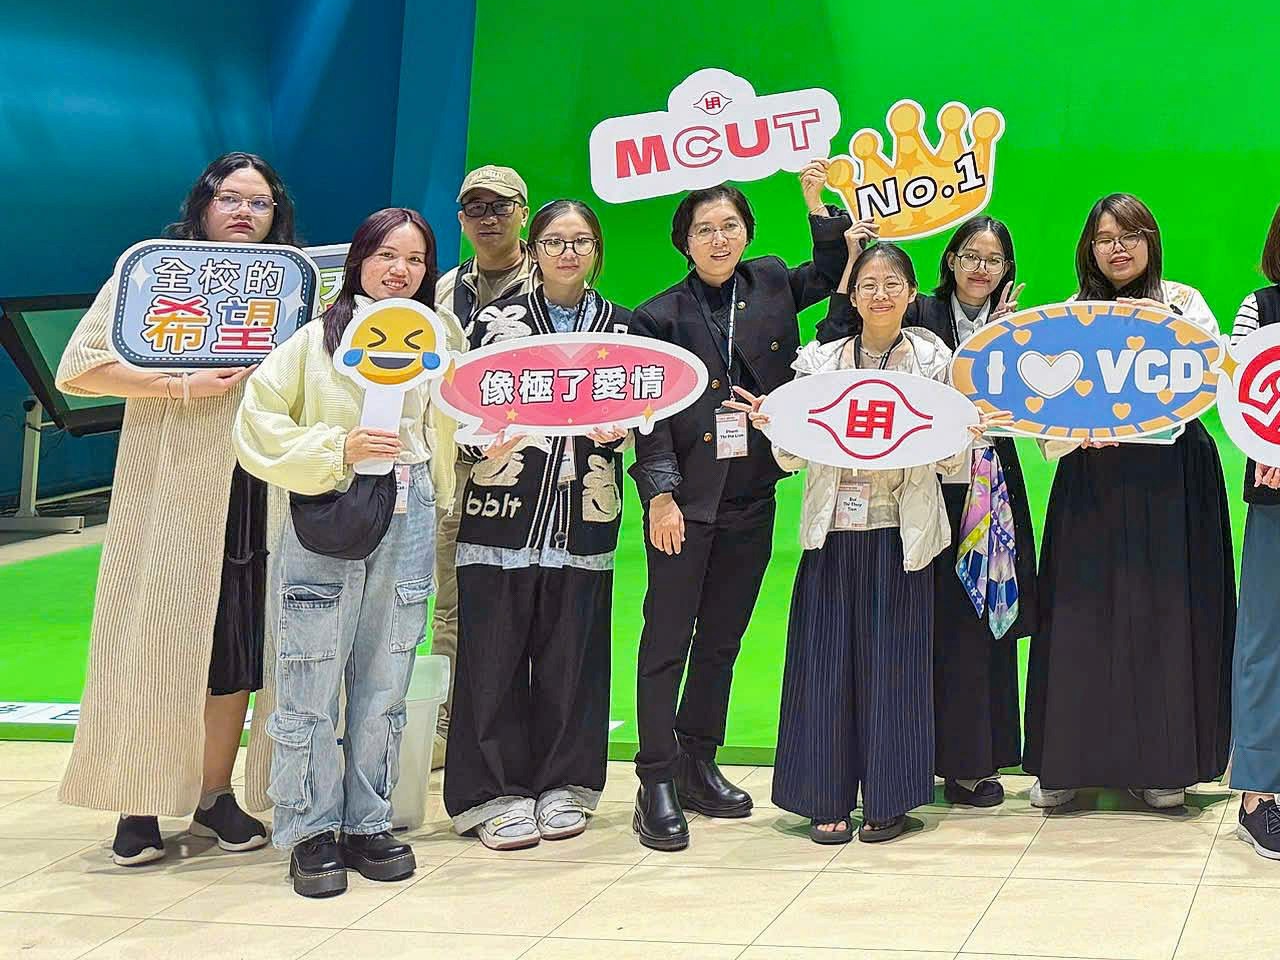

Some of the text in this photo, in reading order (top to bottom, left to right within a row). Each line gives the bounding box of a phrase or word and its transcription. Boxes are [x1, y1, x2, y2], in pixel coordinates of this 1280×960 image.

[615, 108, 821, 179] MCUT
[855, 151, 986, 221] No.1
[151, 257, 286, 296] 全校的
[142, 295, 282, 355] 希望
[478, 365, 665, 407] 像極了愛情
[986, 348, 1205, 394] I VCD
